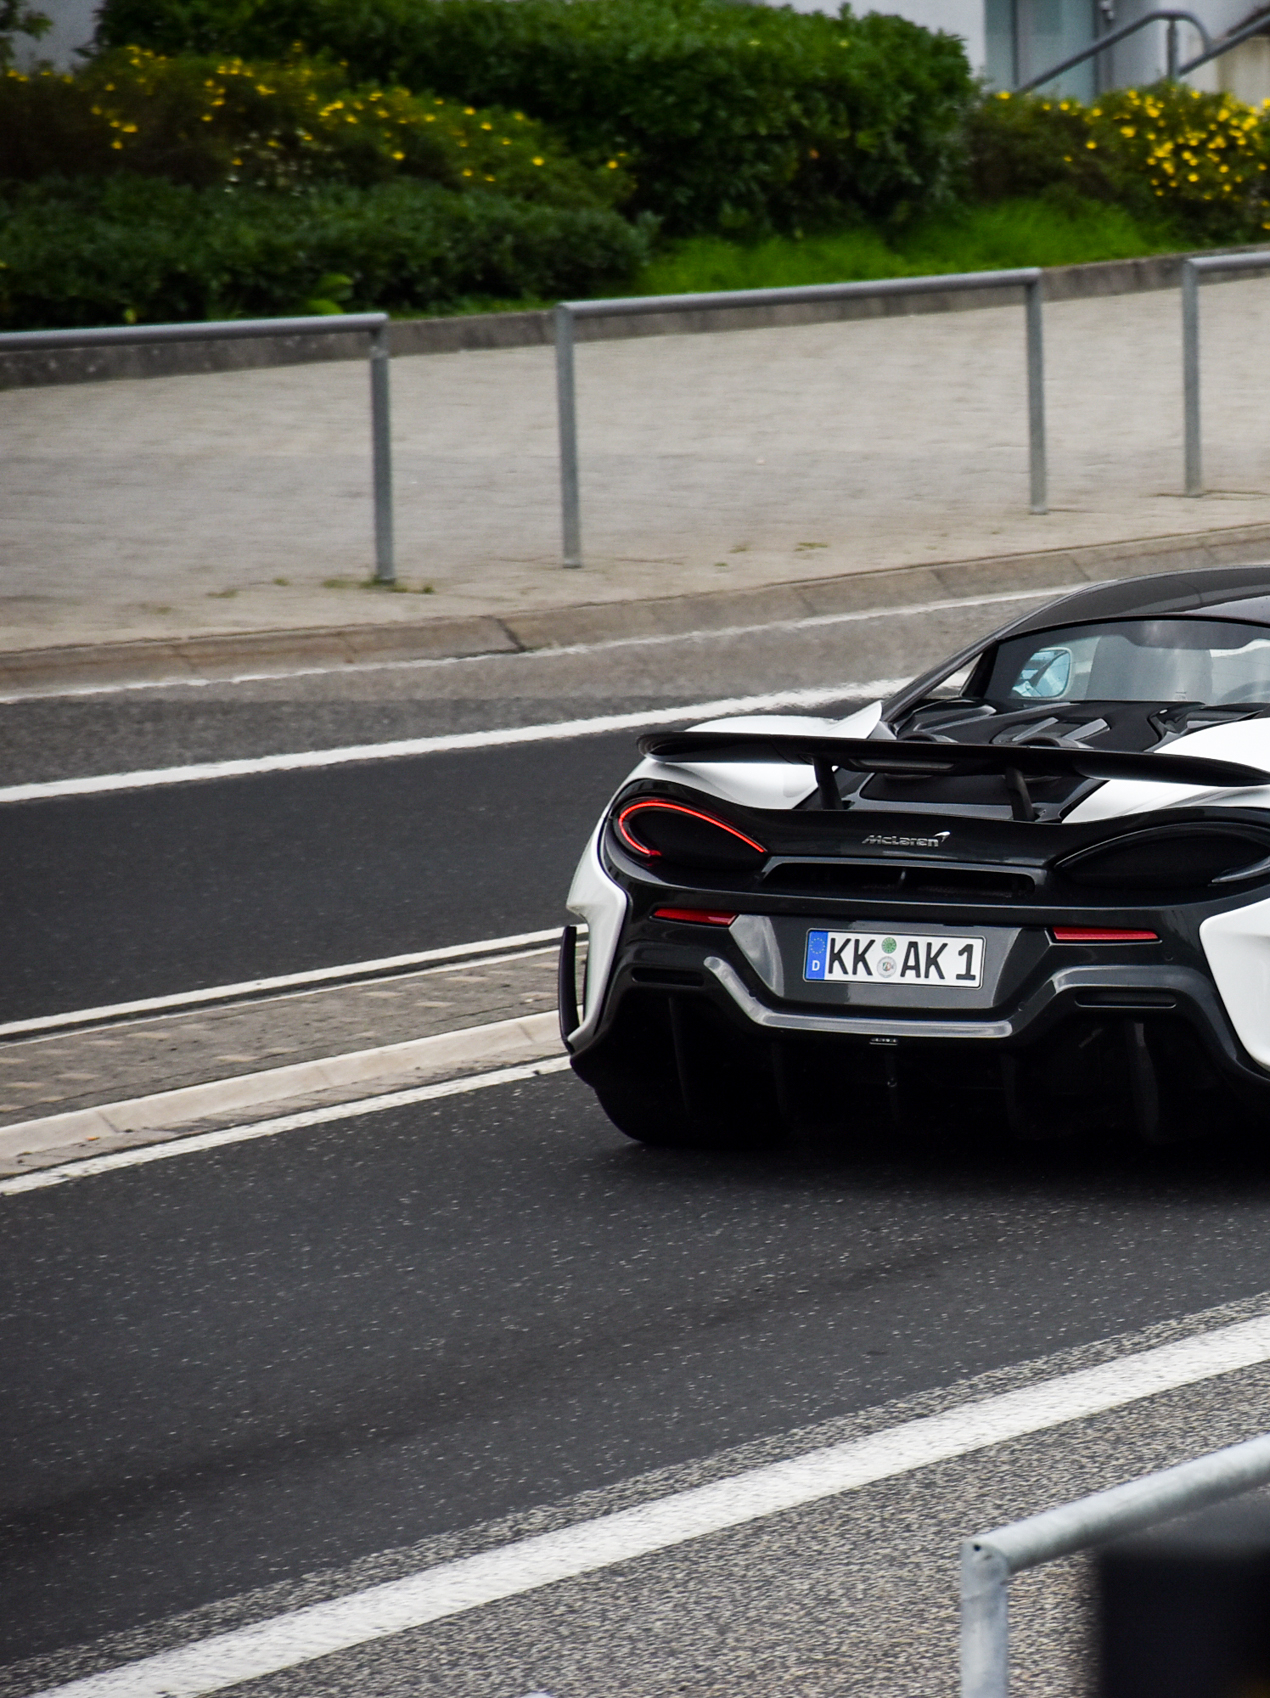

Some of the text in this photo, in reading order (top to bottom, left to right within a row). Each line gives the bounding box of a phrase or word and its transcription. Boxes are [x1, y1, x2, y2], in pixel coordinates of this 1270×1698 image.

[861, 834, 939, 847] McLaren
[812, 960, 820, 971] D
[828, 937, 876, 975] KK
[899, 941, 949, 980] AK
[956, 943, 976, 981] 1
